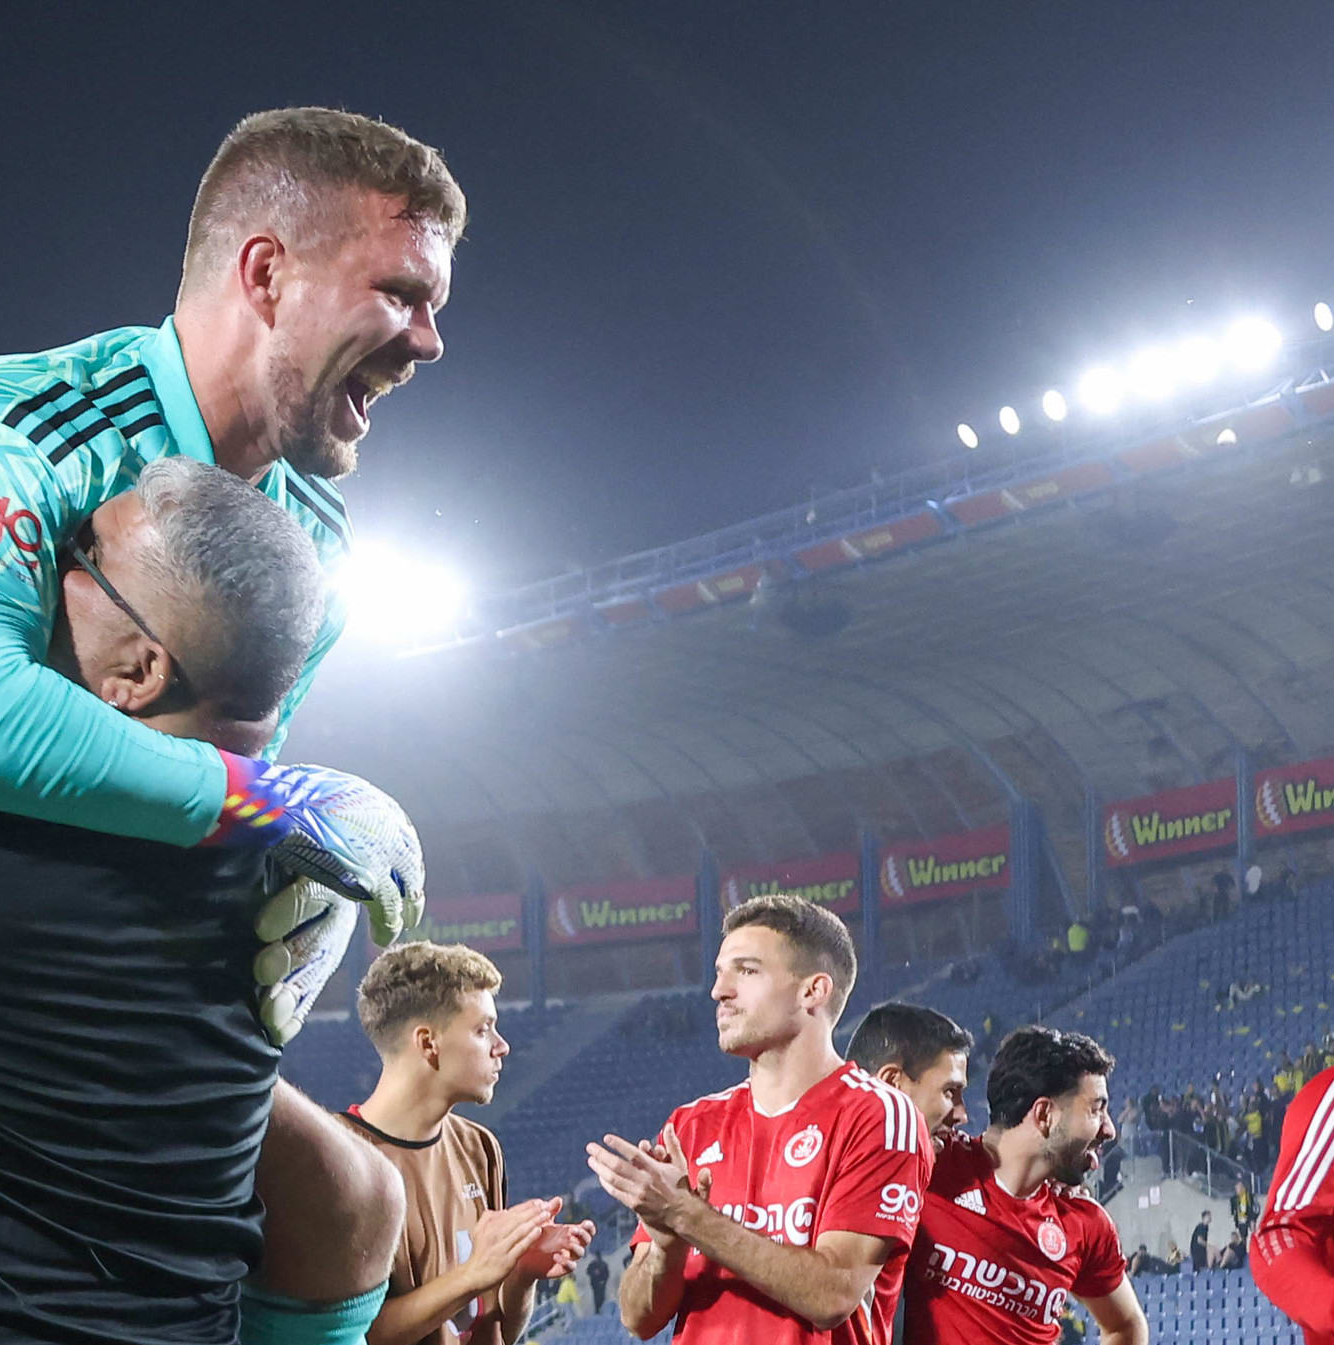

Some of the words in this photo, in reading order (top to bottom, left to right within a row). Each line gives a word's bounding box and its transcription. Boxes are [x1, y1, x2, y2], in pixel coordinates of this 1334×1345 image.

[1130, 808, 1231, 844] Winner
[908, 853, 1006, 887] Winner
[580, 899, 691, 928] Winner
[879, 1183, 919, 1215] go
[928, 1242, 1048, 1307] הכשרה
[961, 1282, 1006, 1307] לביטוח
